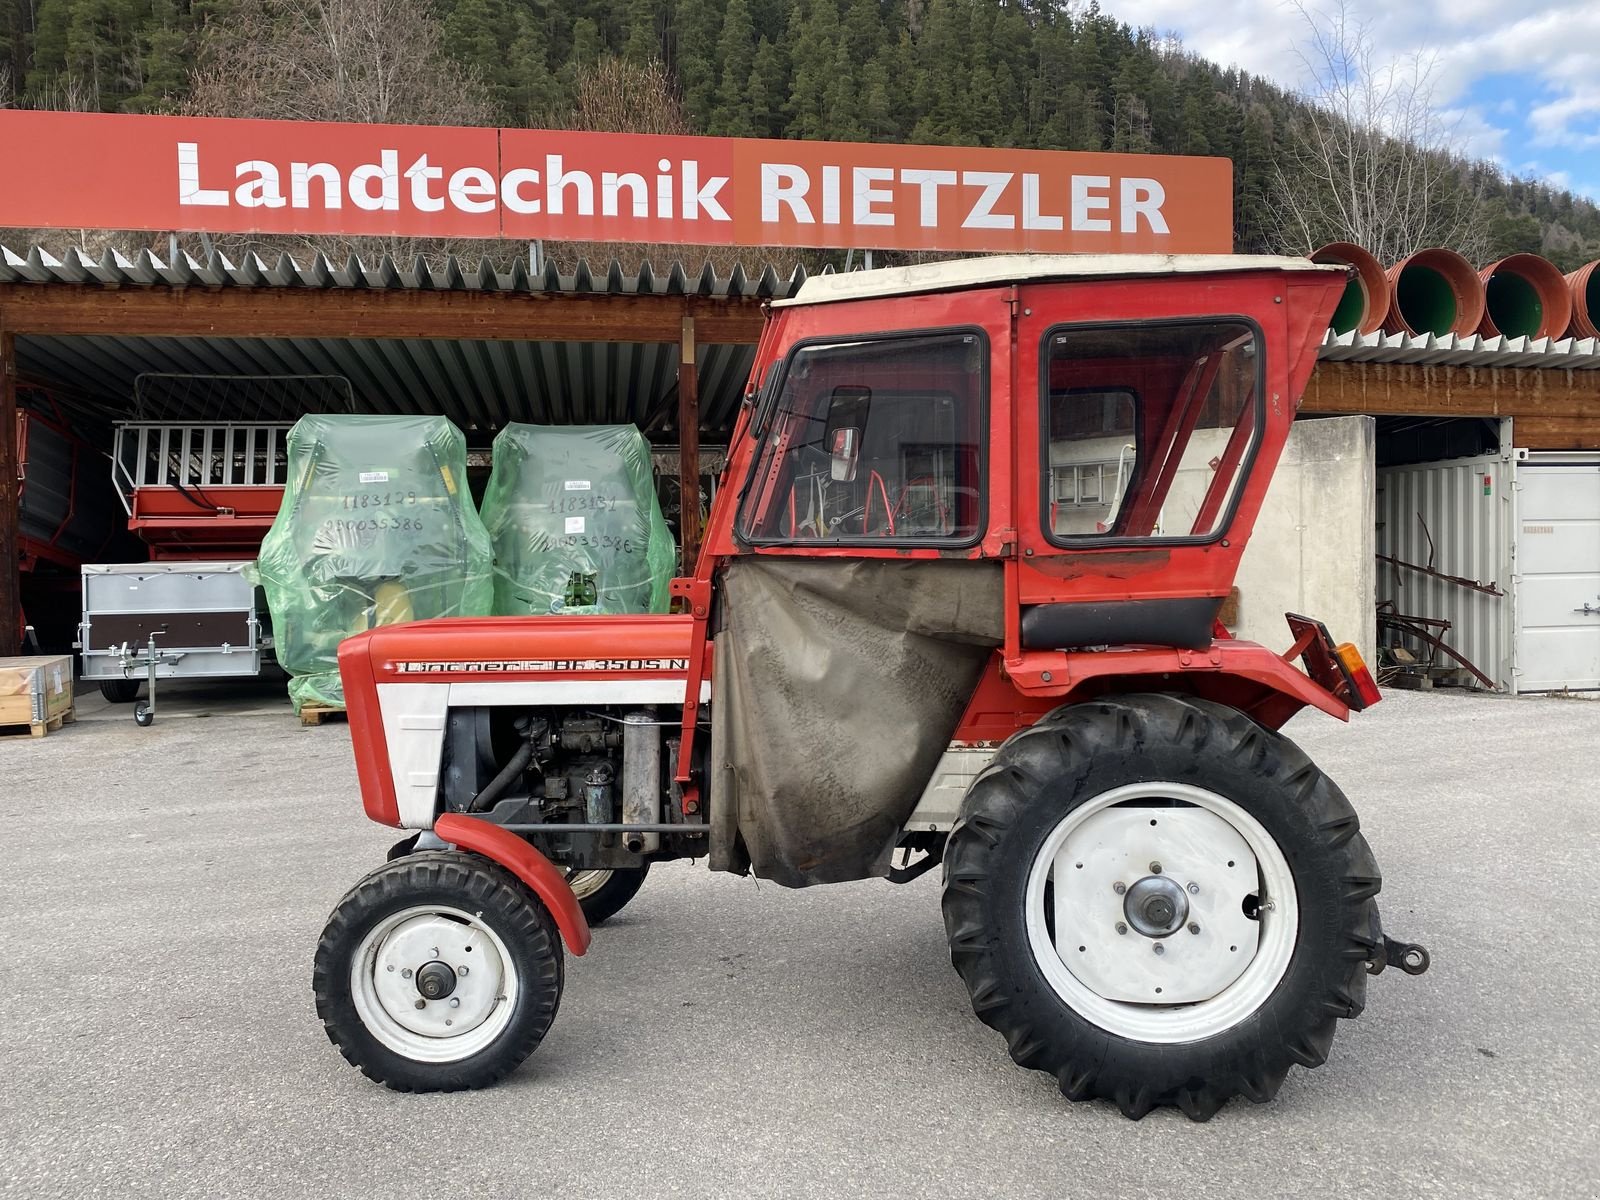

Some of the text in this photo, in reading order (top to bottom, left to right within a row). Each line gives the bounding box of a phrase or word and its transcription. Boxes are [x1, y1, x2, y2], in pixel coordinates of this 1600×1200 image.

[178, 142, 1170, 234] Landtechnik RIETZLER
[343, 491, 416, 509] 1183129
